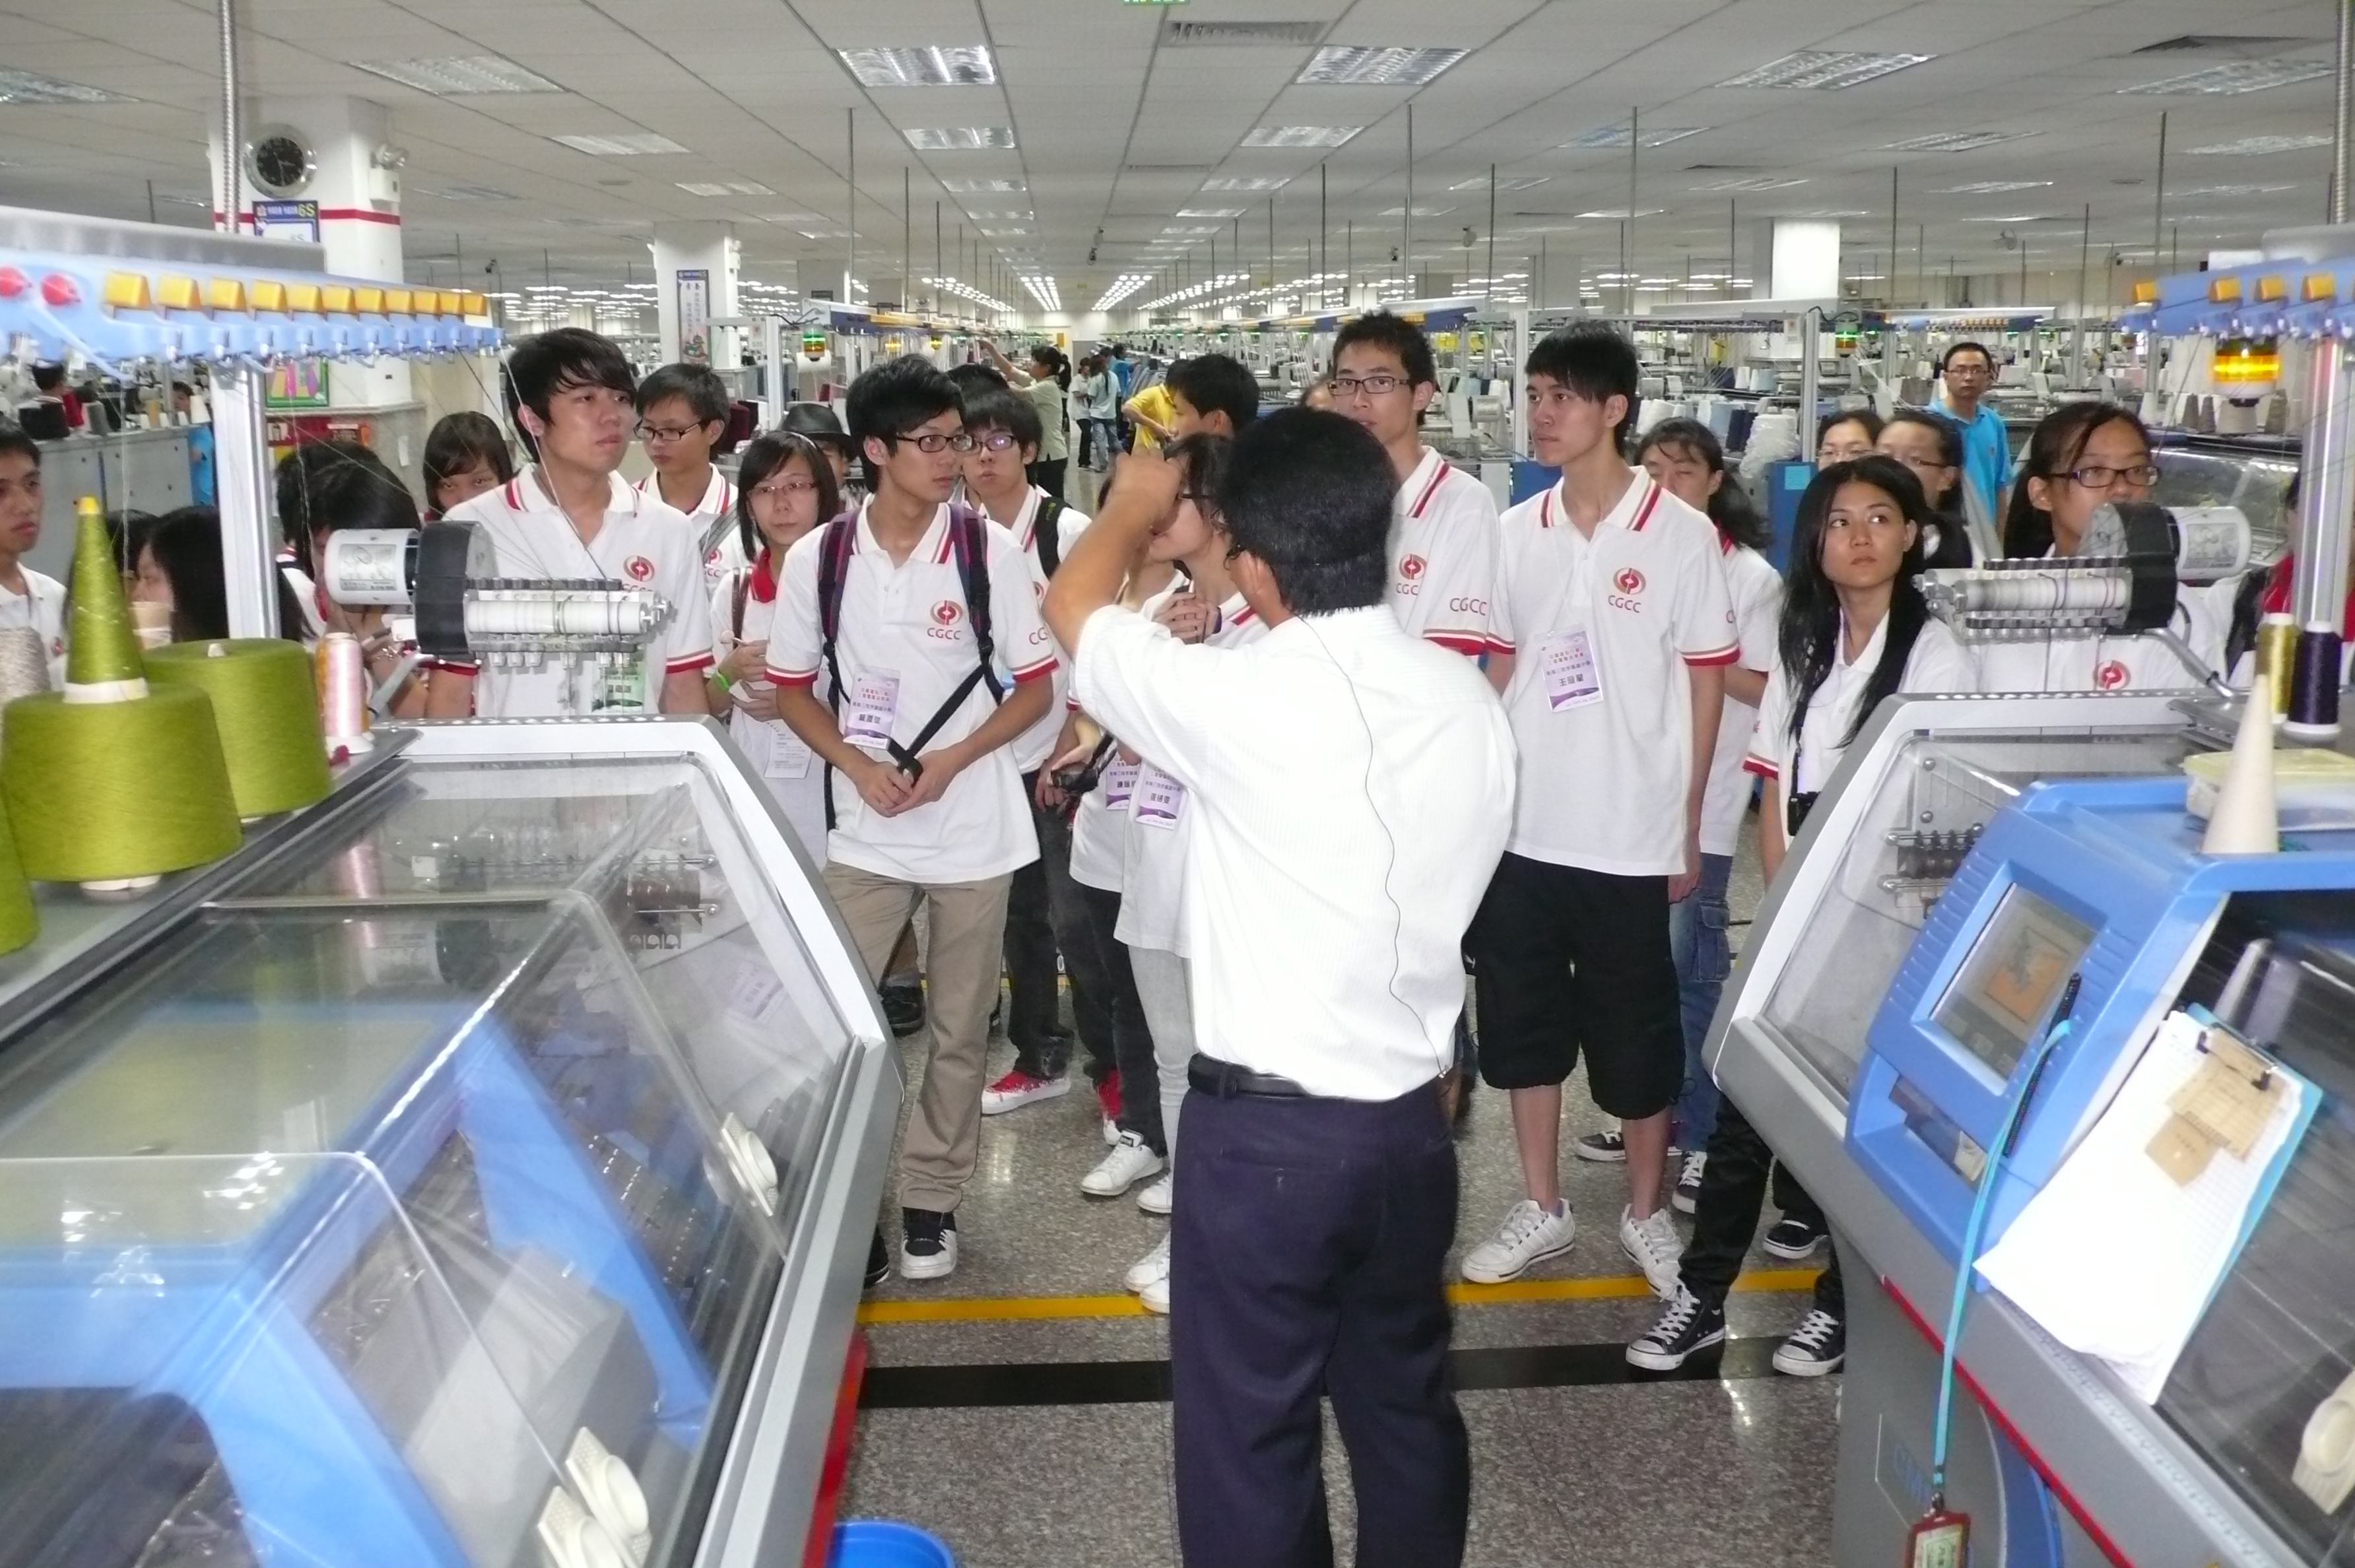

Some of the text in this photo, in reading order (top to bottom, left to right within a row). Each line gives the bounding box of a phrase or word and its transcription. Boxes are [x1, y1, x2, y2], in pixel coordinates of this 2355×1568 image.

[1449, 597, 1487, 616] CGCC
[1608, 595, 1642, 613] CGCC
[927, 627, 962, 640] CGCC
